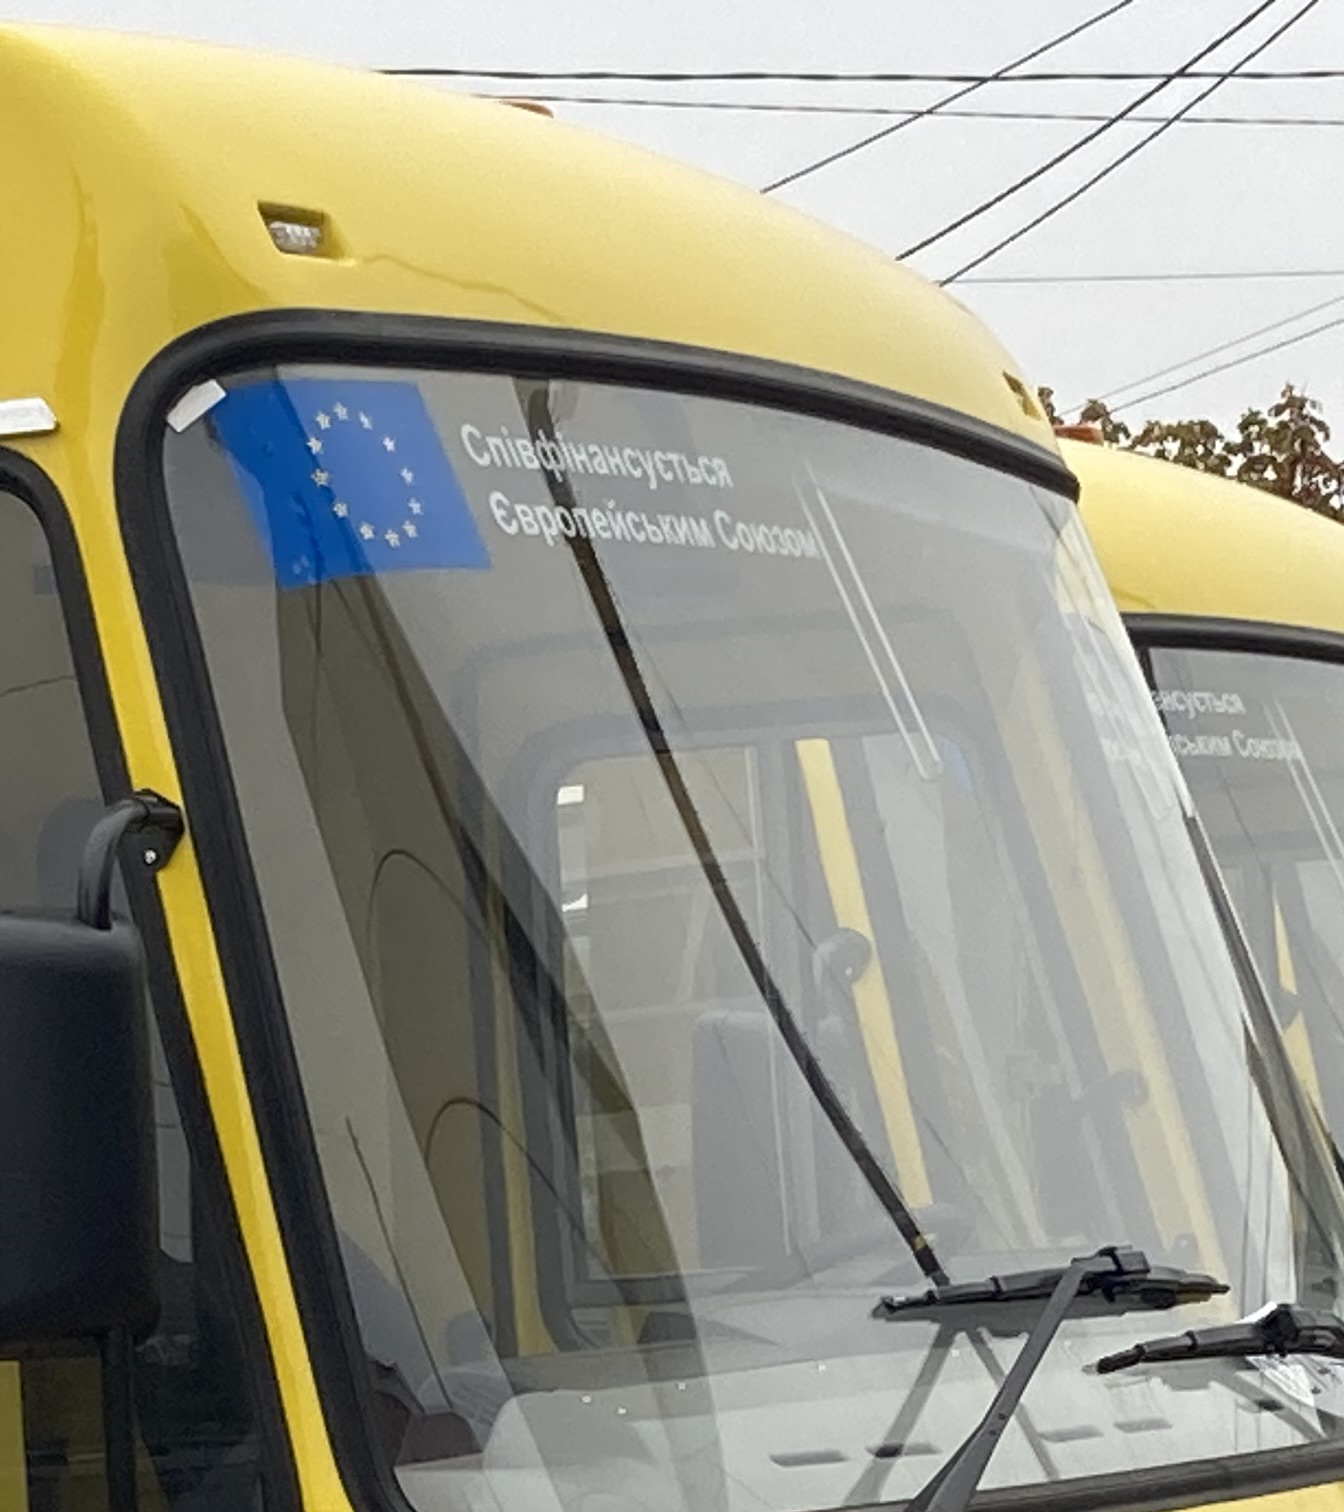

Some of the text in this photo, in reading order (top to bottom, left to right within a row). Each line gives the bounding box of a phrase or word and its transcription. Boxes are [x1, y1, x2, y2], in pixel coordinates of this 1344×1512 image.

[460, 423, 734, 490] Співфінансується
[489, 490, 820, 560] Європейським Союзом
